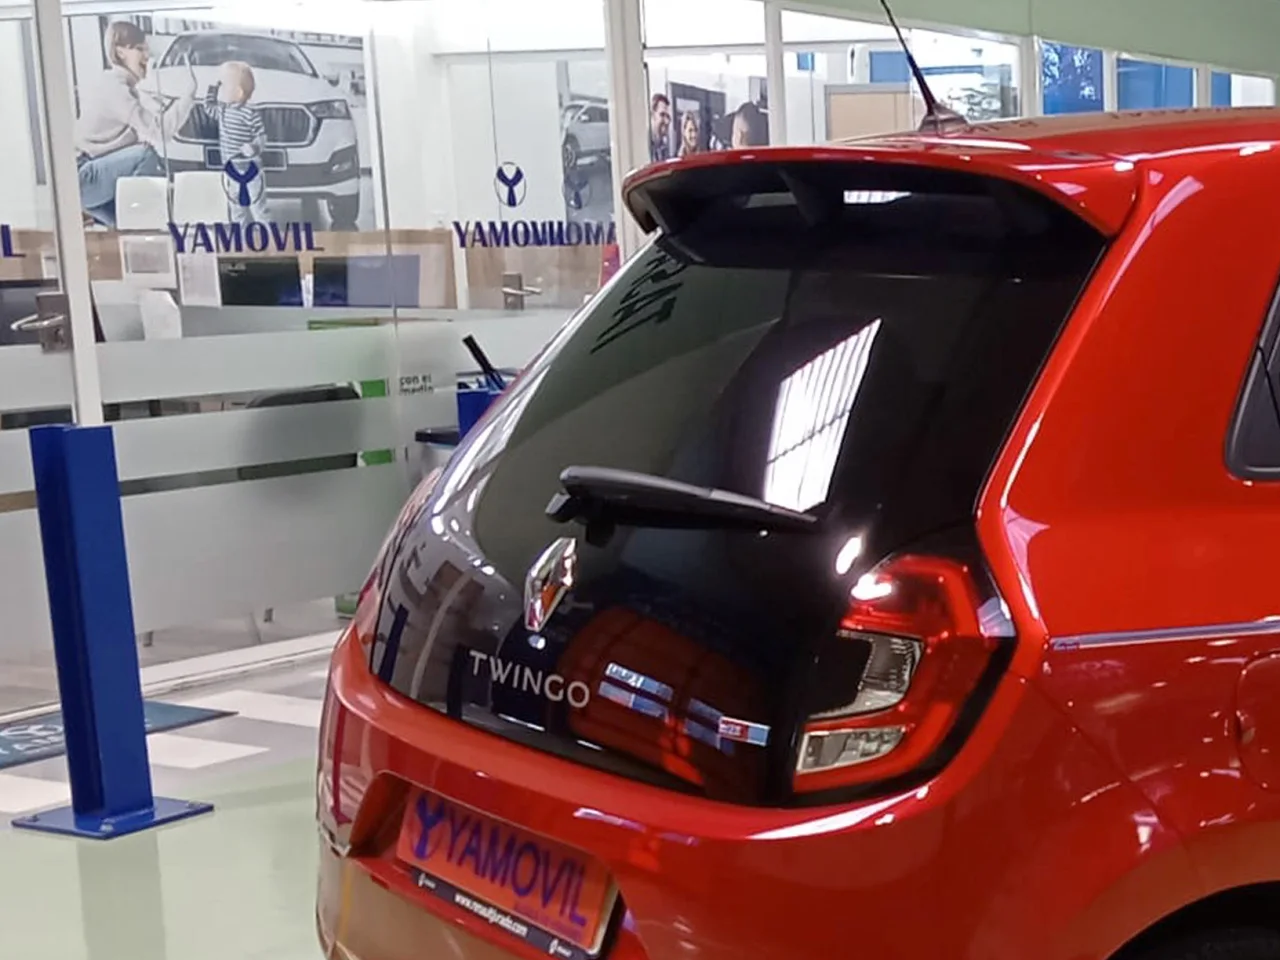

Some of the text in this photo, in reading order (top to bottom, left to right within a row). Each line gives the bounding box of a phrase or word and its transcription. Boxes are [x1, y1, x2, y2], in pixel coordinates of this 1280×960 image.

[168, 221, 325, 254] YAMOVIL
[469, 650, 590, 709] TWINGO
[446, 808, 587, 927] YAMOVIL
